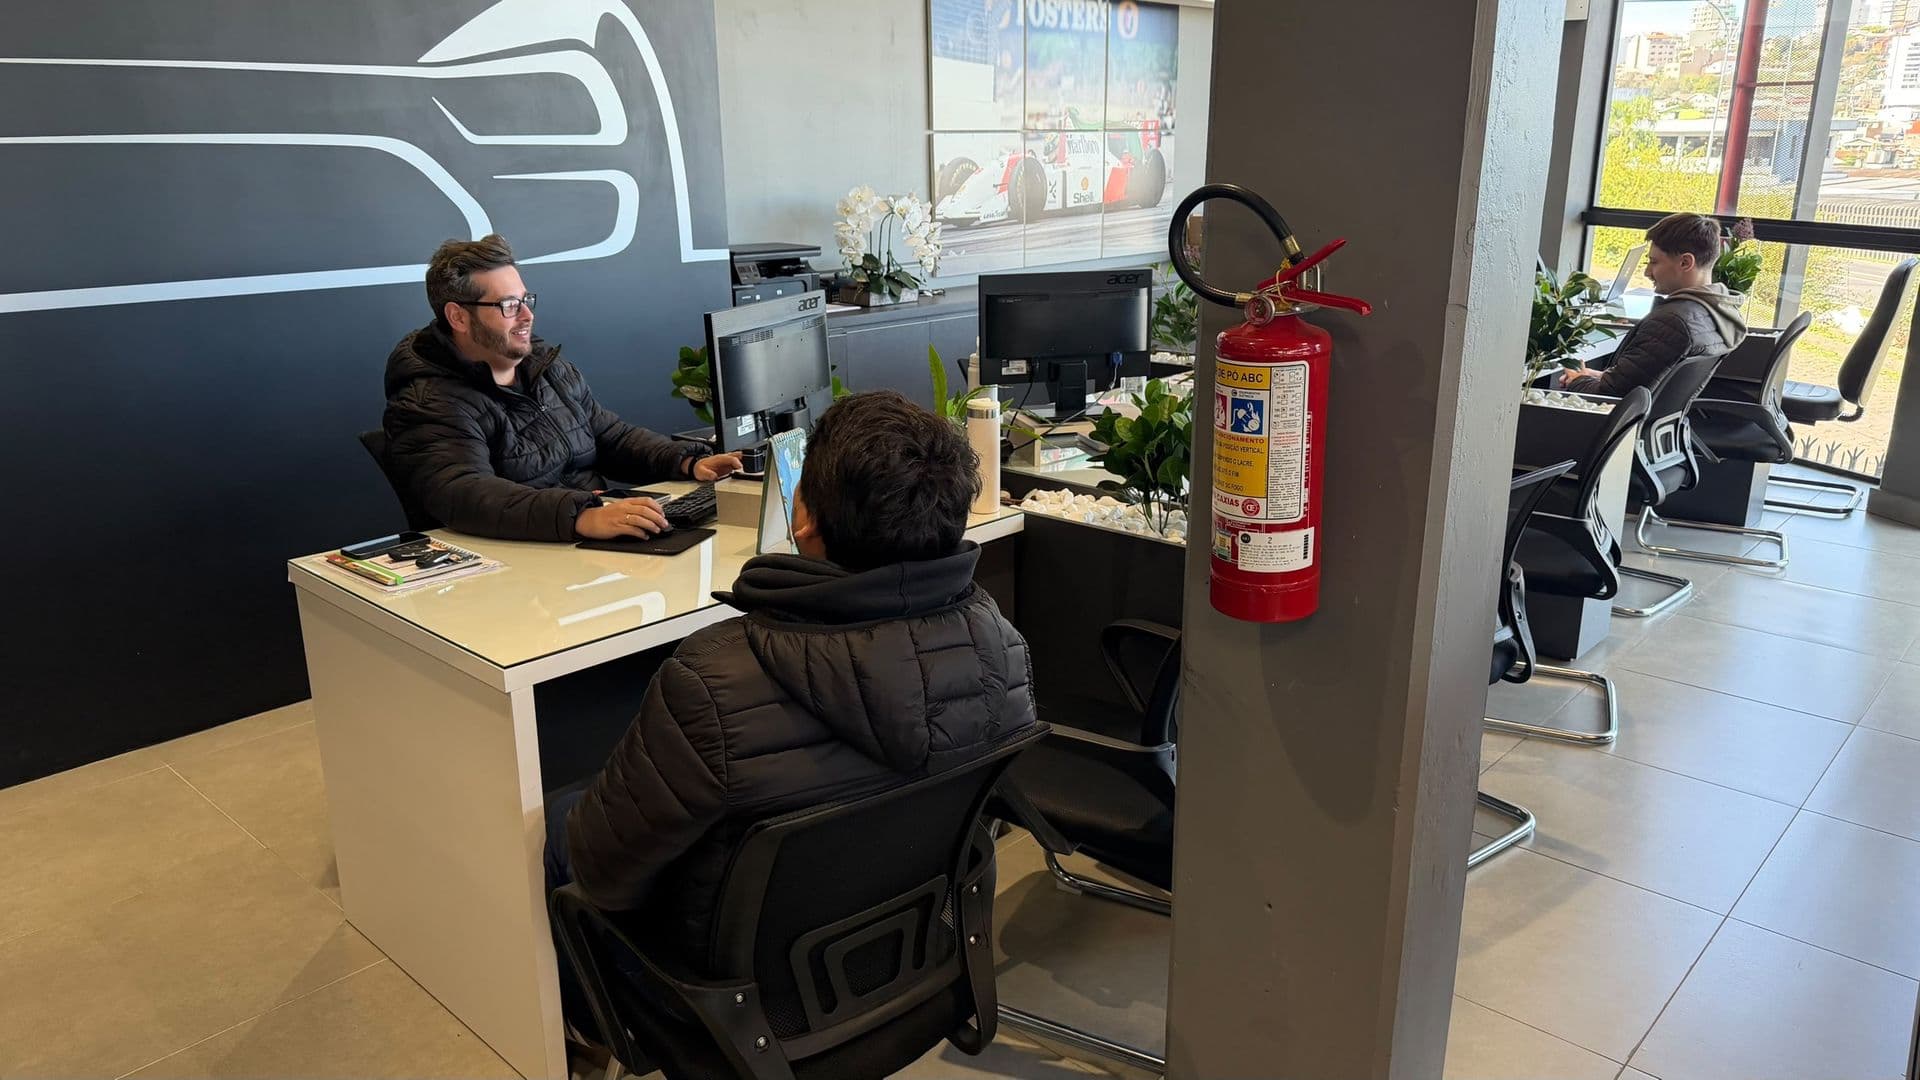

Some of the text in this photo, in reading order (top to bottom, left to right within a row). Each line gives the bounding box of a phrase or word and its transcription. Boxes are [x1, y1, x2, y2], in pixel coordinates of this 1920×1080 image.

[1107, 274, 1144, 285] acer
[798, 295, 821, 311] acer
[1240, 373, 1263, 383] ABC
[1267, 536, 1273, 544] 2
